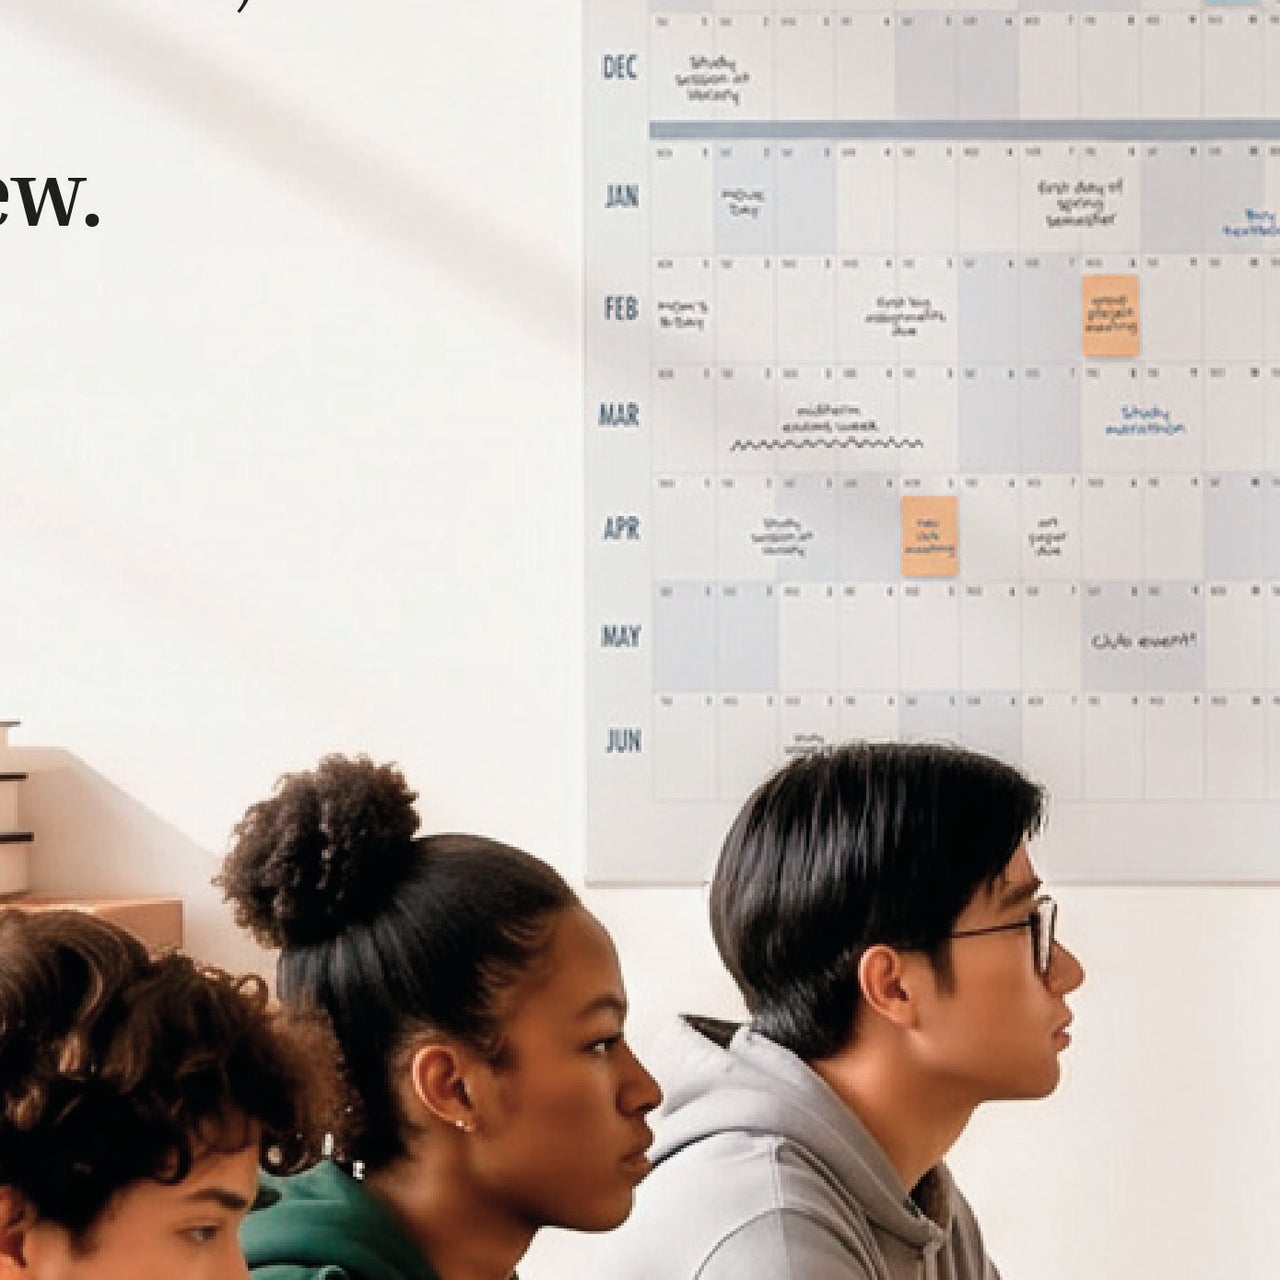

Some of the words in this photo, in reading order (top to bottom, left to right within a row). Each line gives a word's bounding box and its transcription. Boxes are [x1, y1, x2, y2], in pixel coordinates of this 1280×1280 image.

[604, 54, 637, 79] DEC
[606, 185, 639, 208] JAN
[605, 295, 639, 320] FEB
[598, 402, 639, 427] MAR
[604, 516, 640, 539] APR
[601, 625, 641, 647] MAY
[606, 728, 641, 752] JUN
